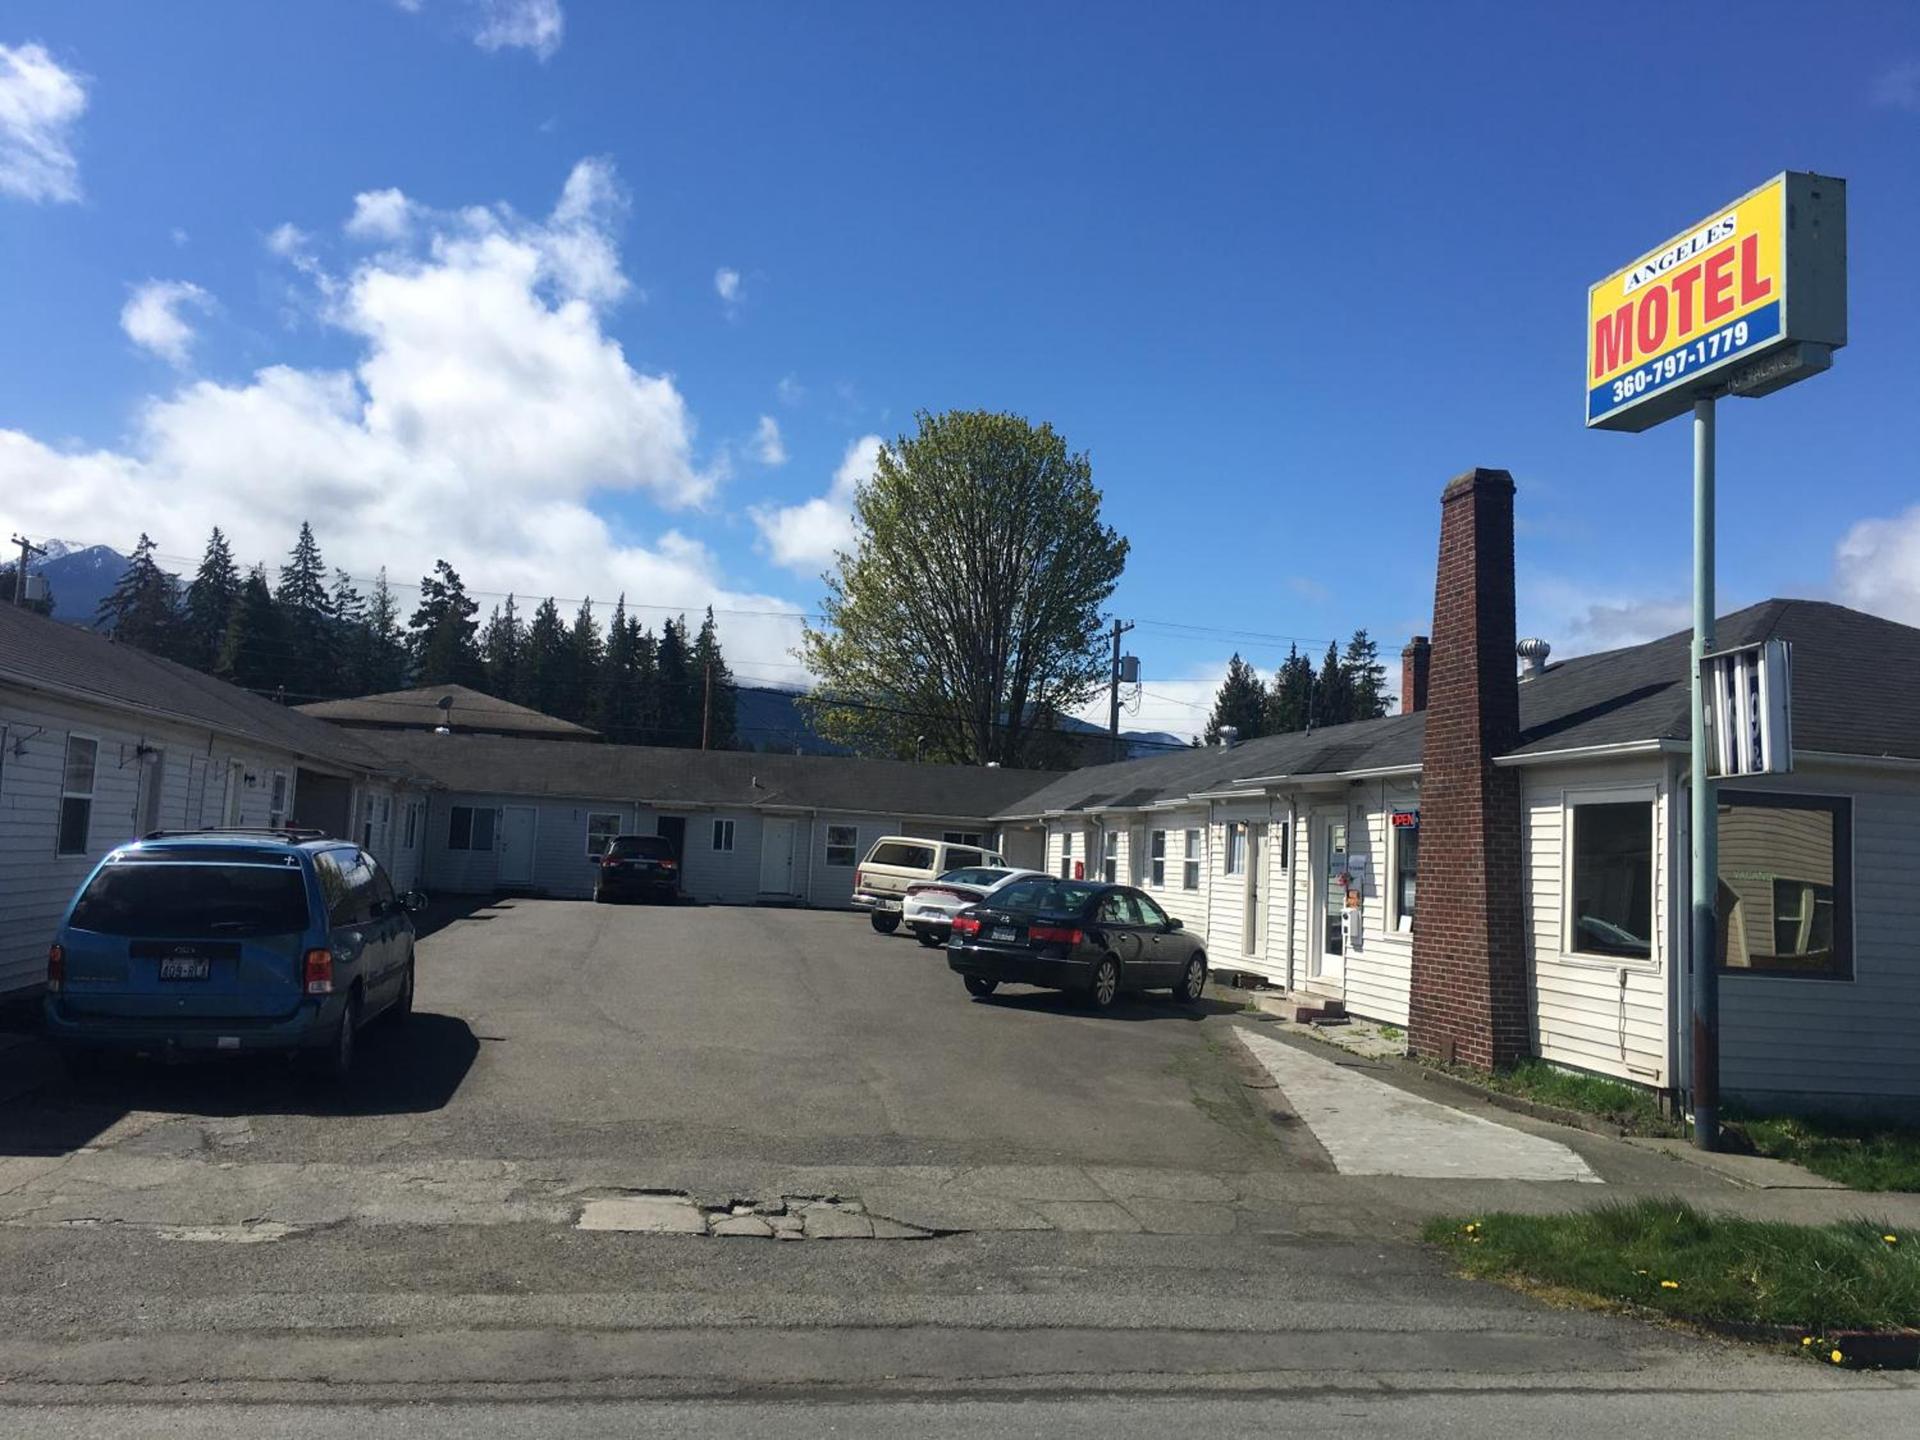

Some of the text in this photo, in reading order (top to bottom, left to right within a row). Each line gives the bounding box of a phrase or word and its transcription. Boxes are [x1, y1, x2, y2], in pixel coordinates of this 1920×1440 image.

[1627, 216, 1735, 290] ANGELES
[1594, 233, 1772, 380] MOTEL
[1613, 321, 1748, 403] 360-797-1779
[1392, 813, 1414, 826] OPEN
